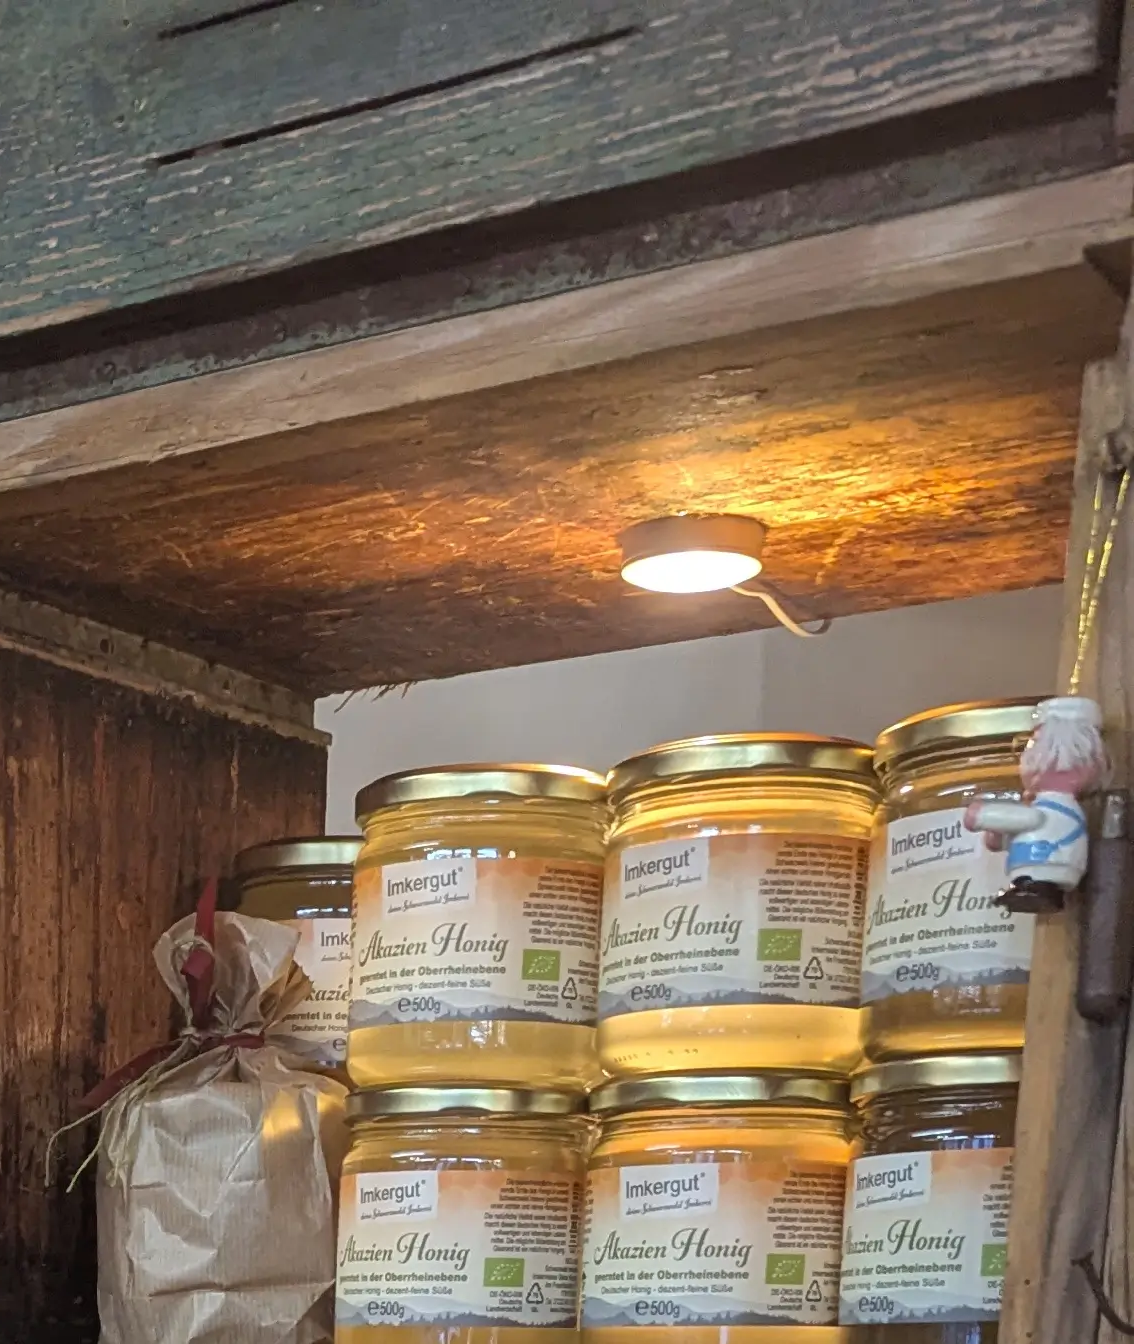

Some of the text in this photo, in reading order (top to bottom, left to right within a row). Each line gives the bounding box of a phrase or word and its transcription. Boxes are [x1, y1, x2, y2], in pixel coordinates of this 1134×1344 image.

[663, 904, 743, 944] Honig
[358, 922, 509, 967] Akazien Honig
[400, 965, 506, 977] der Oberrheinebene
[340, 1232, 470, 1271] Akazien Honig
[594, 1227, 753, 1267] Akazien Honig
[887, 1218, 966, 1260] Honig
[385, 1272, 467, 1283] Oberrheinebene
[627, 1270, 654, 1280] in der
